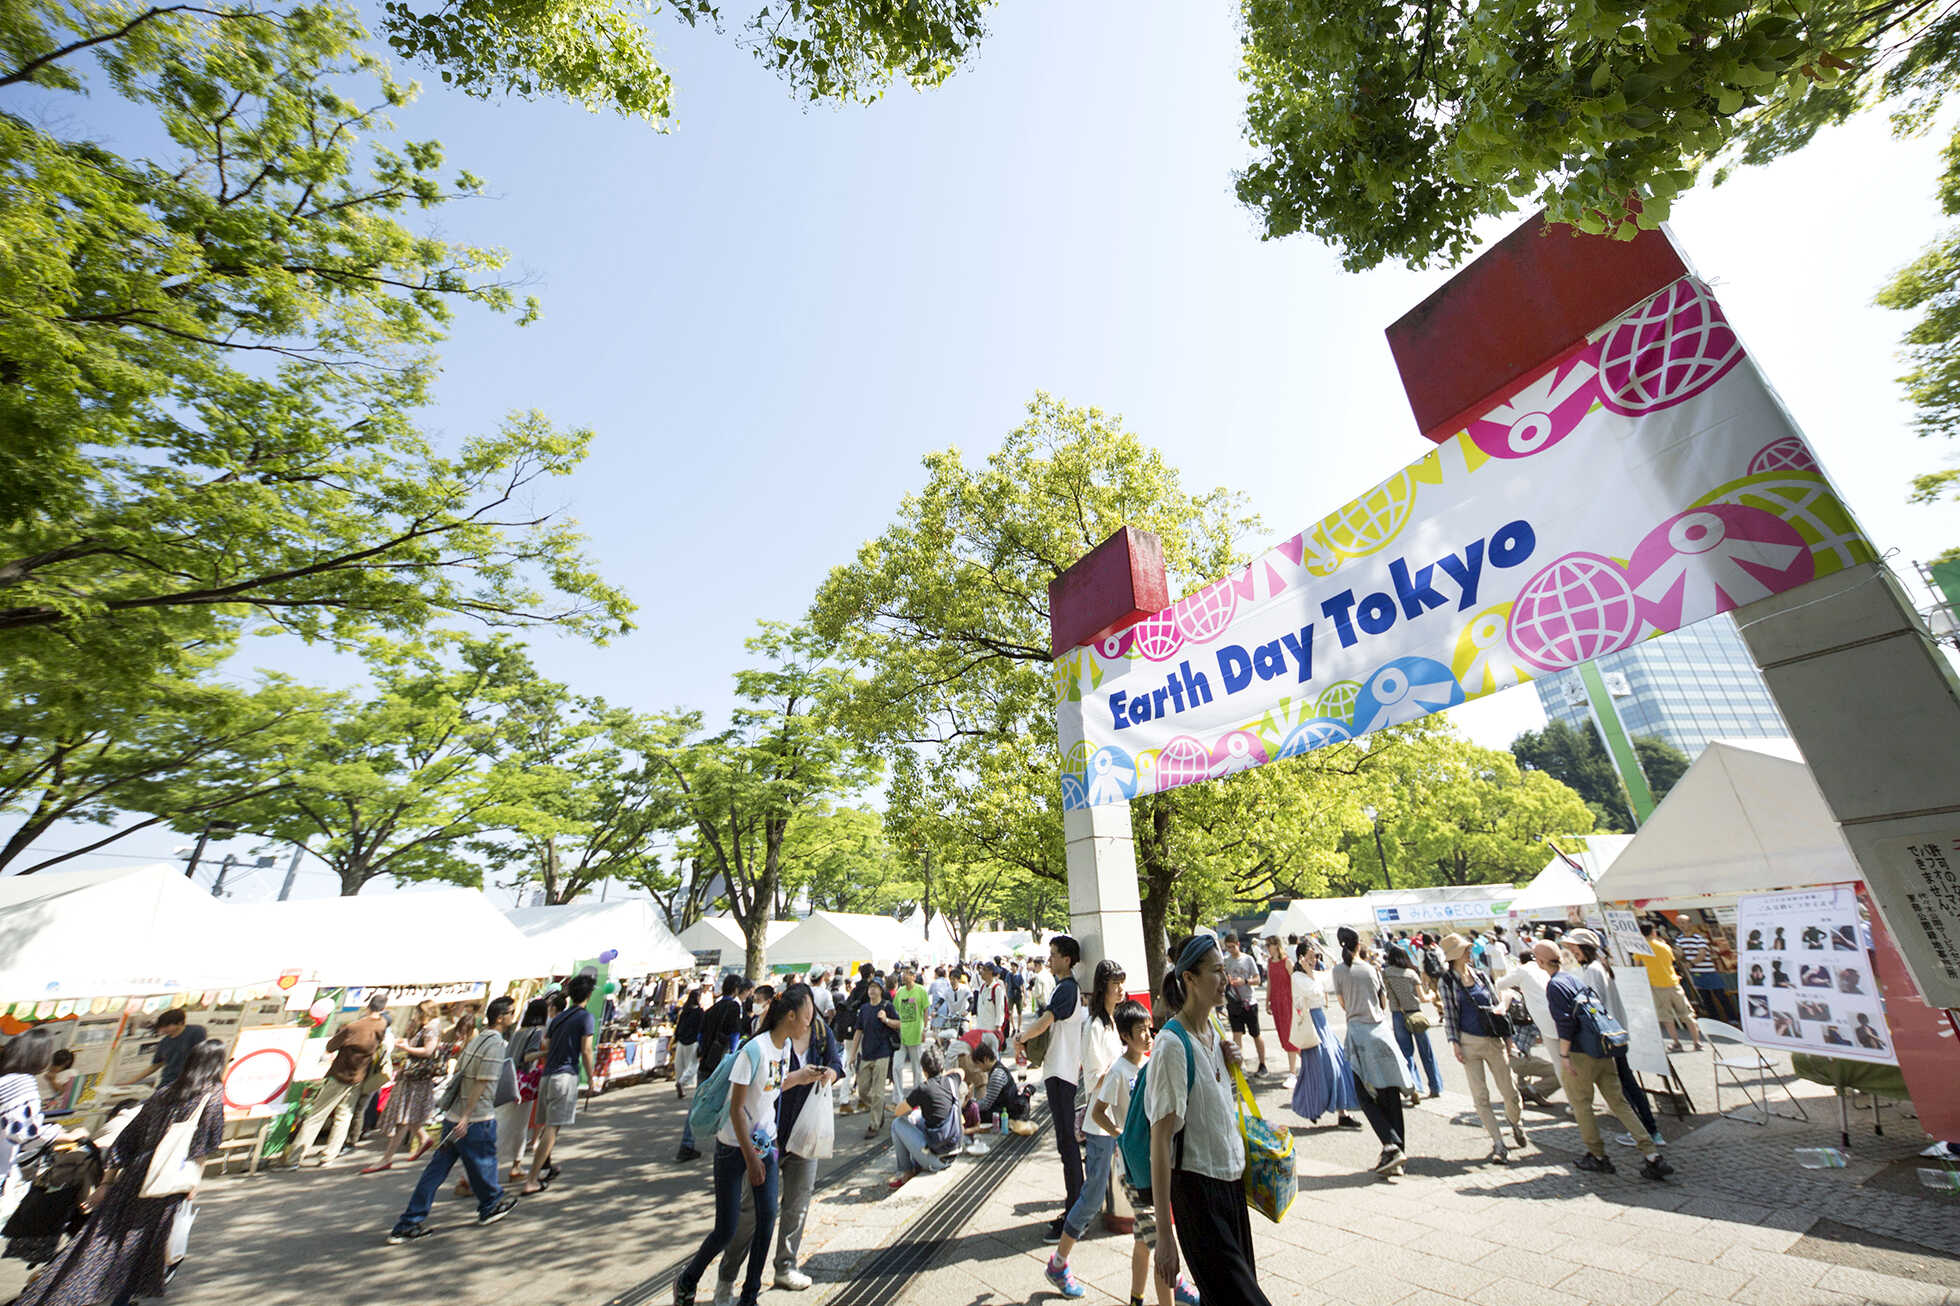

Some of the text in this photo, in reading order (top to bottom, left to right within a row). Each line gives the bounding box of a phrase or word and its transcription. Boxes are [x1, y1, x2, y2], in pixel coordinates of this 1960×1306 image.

[1109, 519, 1536, 730] Earth Day Tokyo
[1907, 845, 1955, 916] できません。
